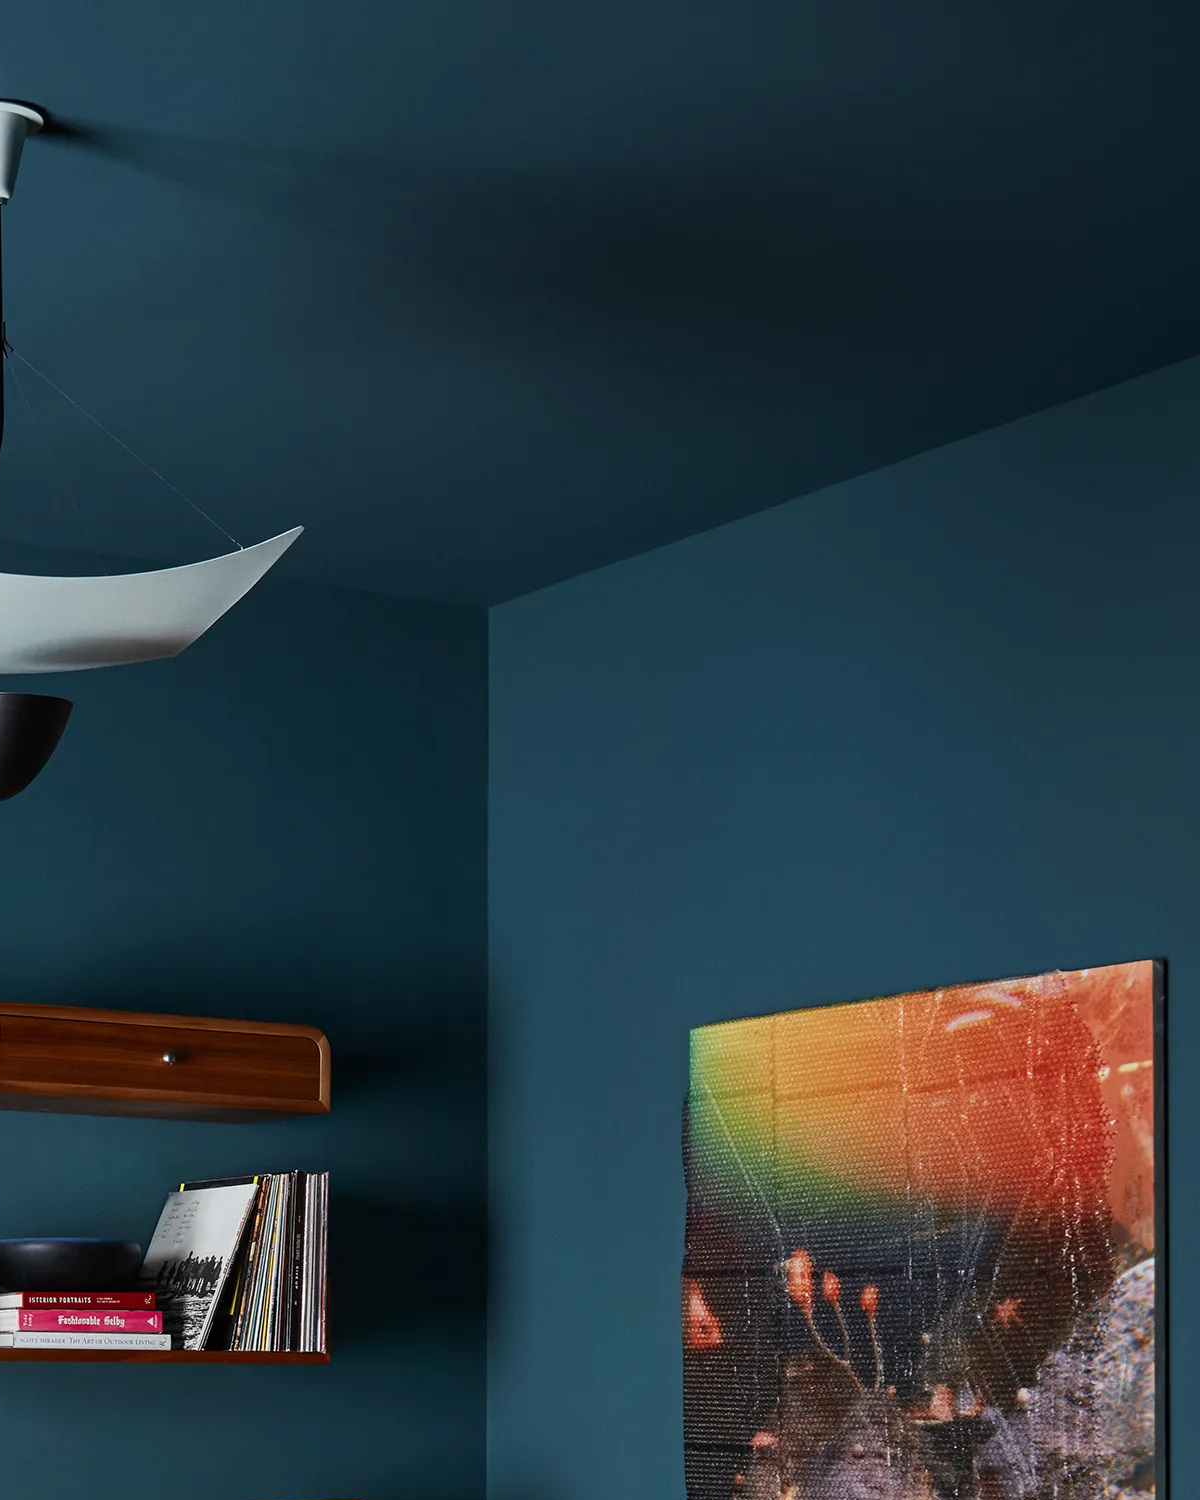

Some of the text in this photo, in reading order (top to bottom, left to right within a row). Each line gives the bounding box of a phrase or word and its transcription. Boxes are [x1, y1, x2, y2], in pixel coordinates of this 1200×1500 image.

[28, 1296, 58, 1304] INTERIOR
[59, 1296, 92, 1304] PORTRAITS
[57, 1315, 125, 1328] Fashionable Selby
[69, 1337, 81, 1345] THE
[103, 1338, 134, 1346] OUTDOOR
